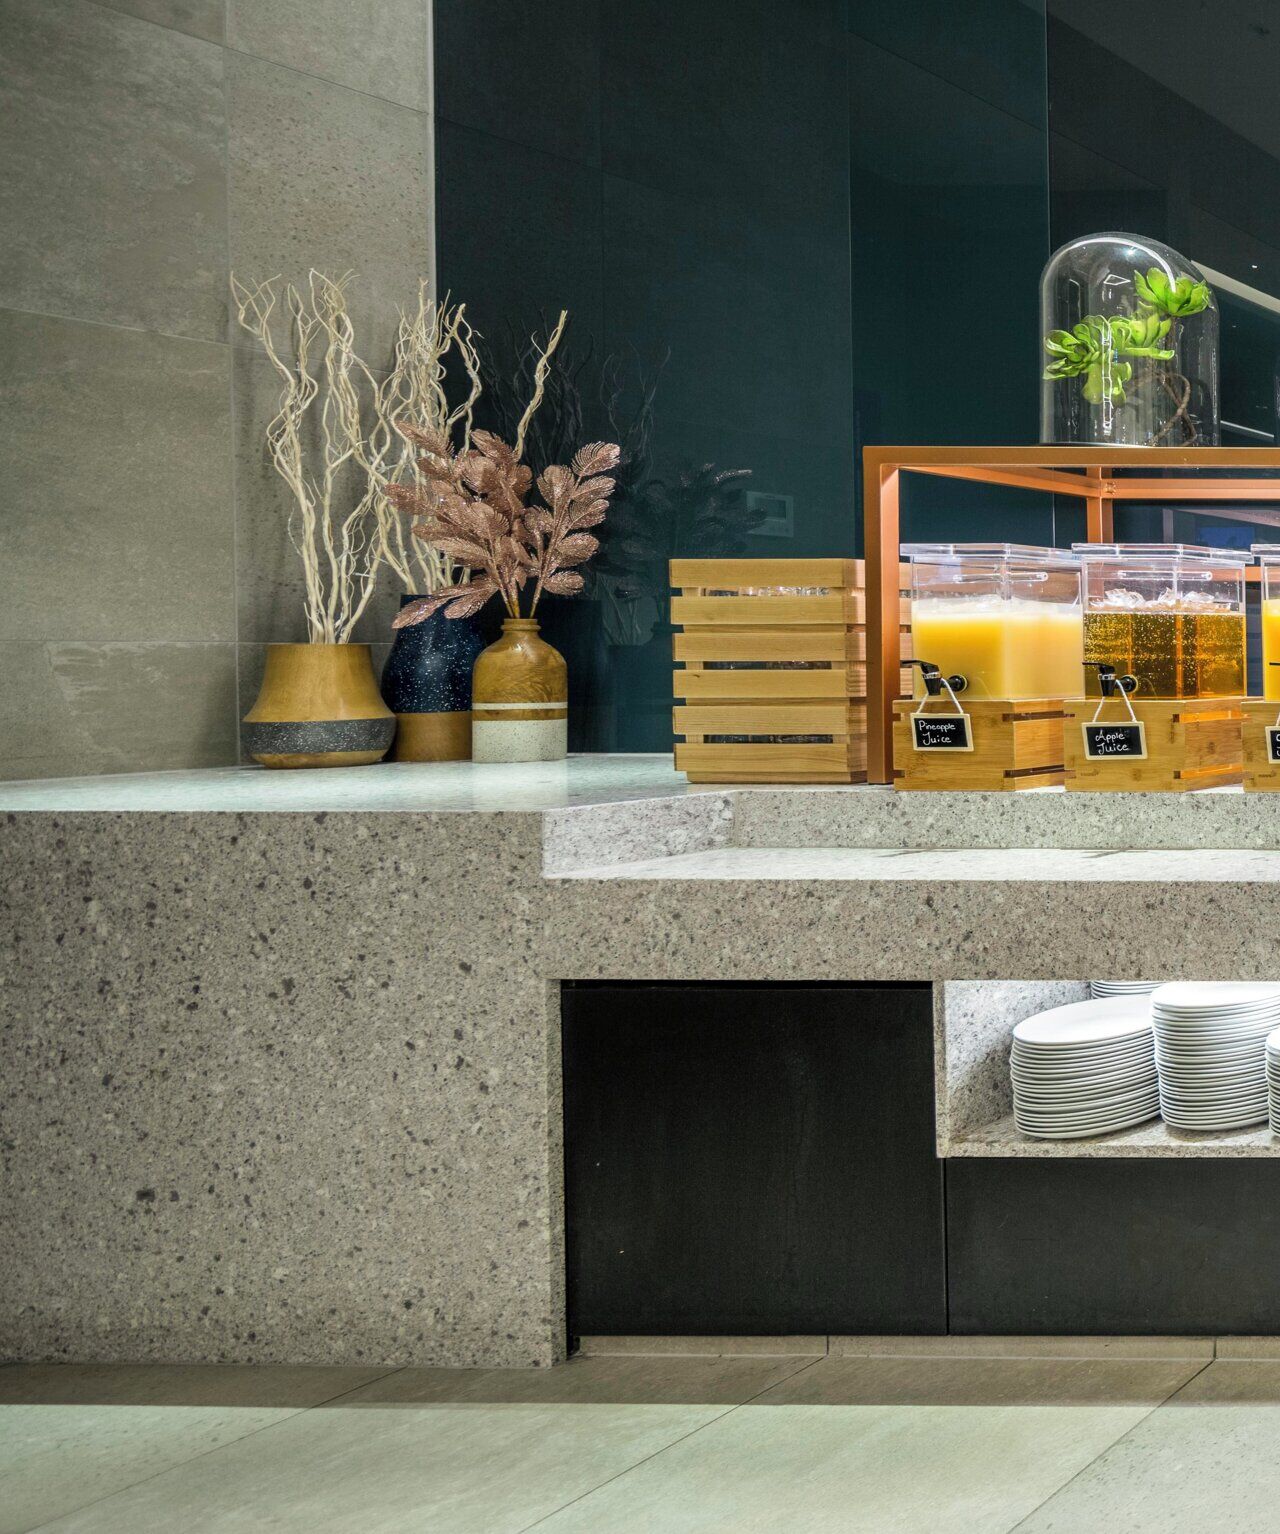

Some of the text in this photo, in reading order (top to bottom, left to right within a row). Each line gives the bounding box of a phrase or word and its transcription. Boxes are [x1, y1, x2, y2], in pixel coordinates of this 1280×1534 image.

[918, 720, 956, 732] Pineapple
[922, 732, 952, 746] Juice
[1095, 730, 1126, 744] Apple
[1096, 742, 1129, 755] Juice
